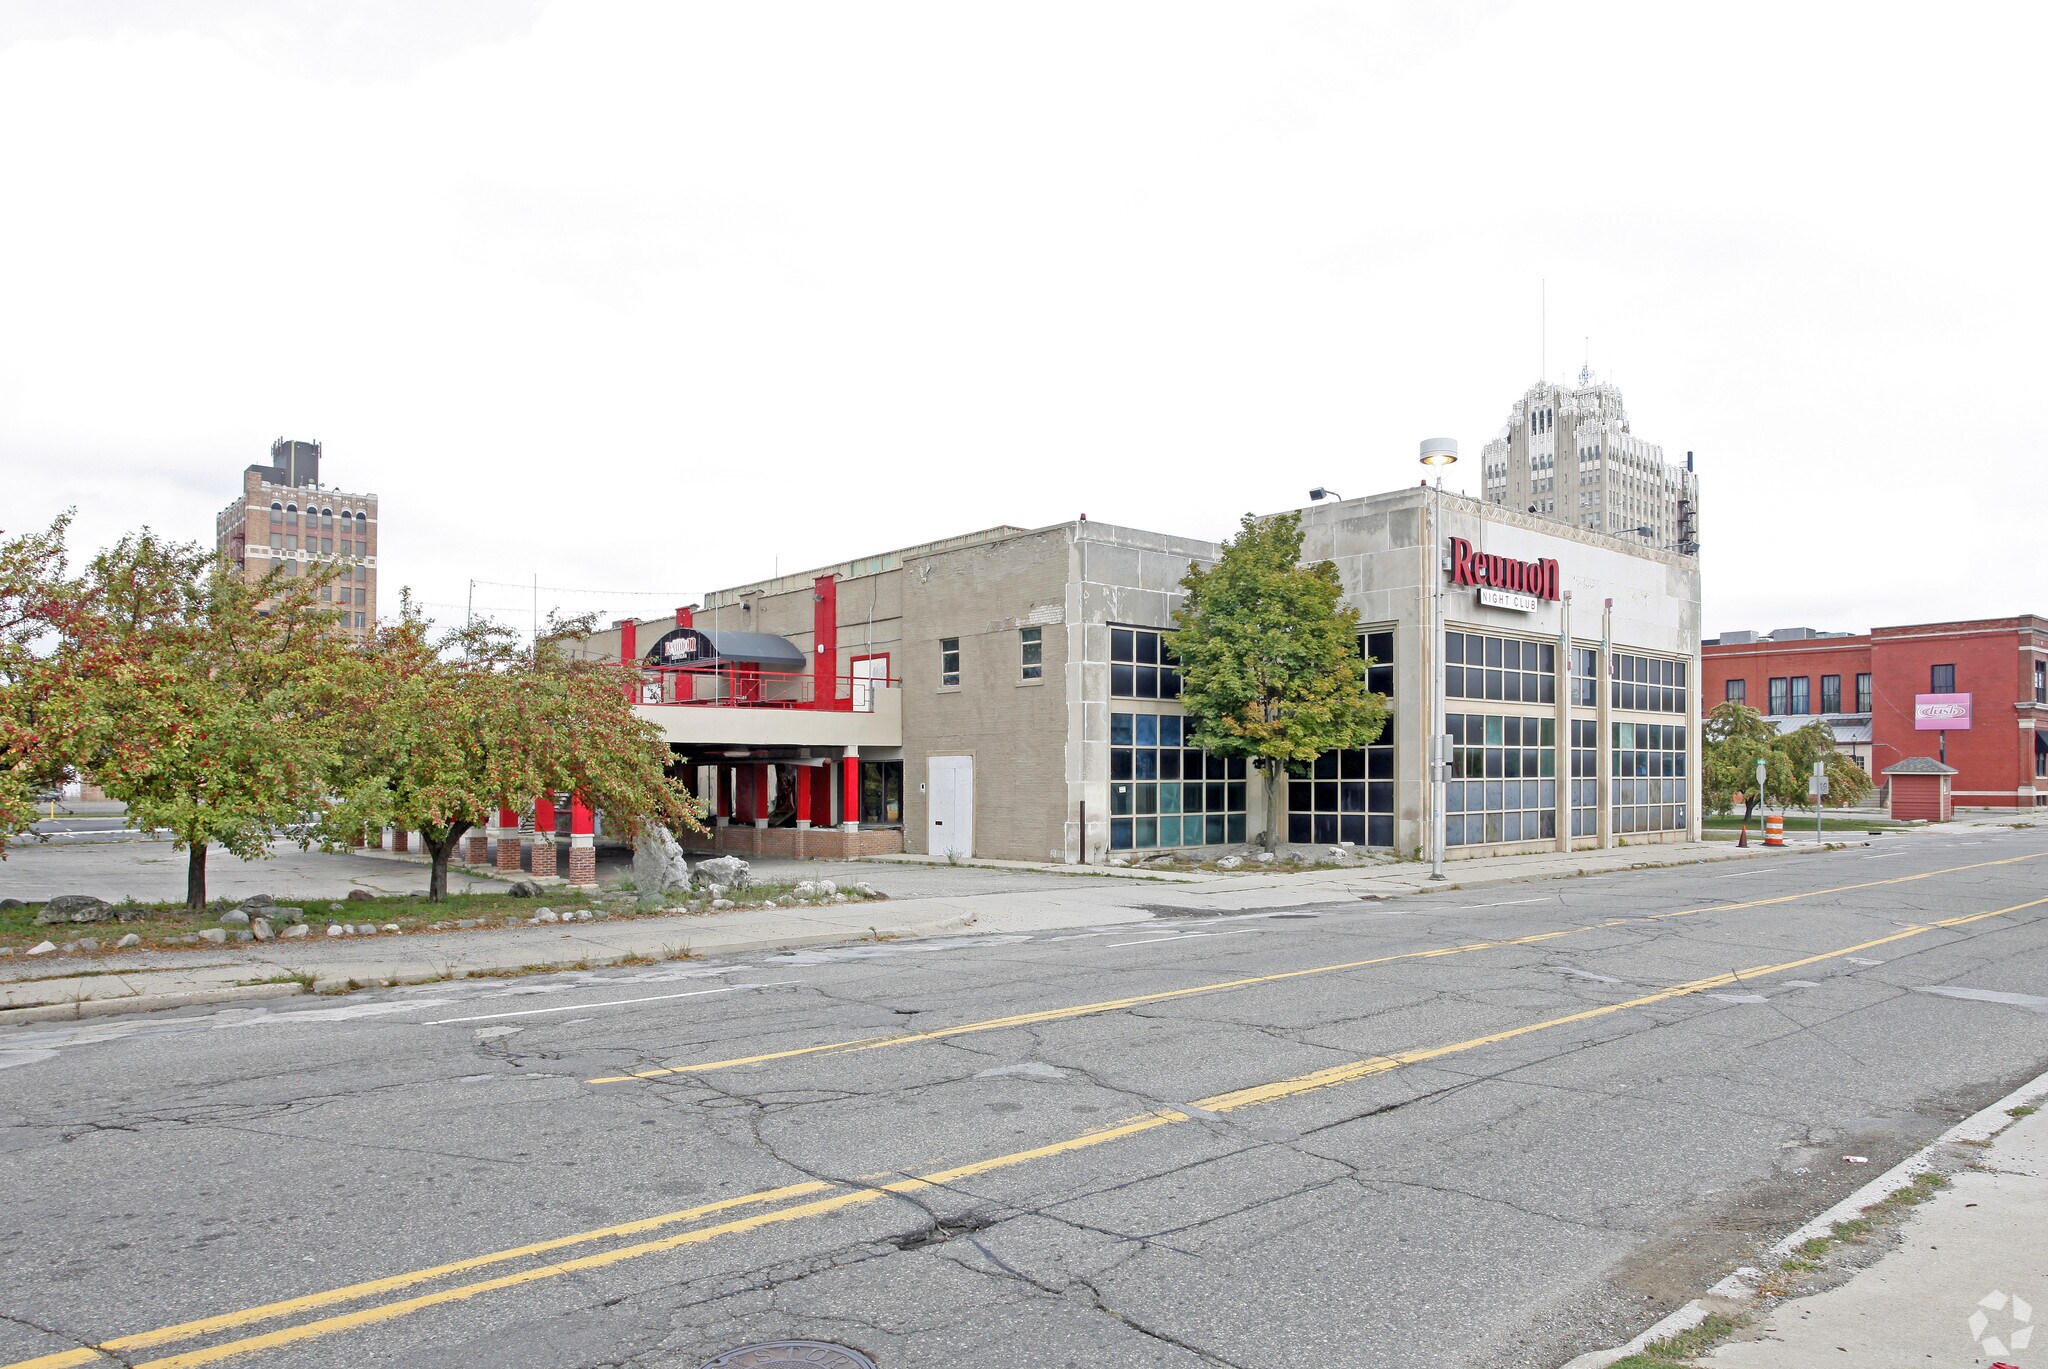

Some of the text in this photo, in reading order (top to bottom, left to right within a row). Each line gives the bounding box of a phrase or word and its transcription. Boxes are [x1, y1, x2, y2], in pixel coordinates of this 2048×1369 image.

[1448, 536, 1560, 601] Reunion
[1482, 591, 1536, 610] NIGHT CLUB
